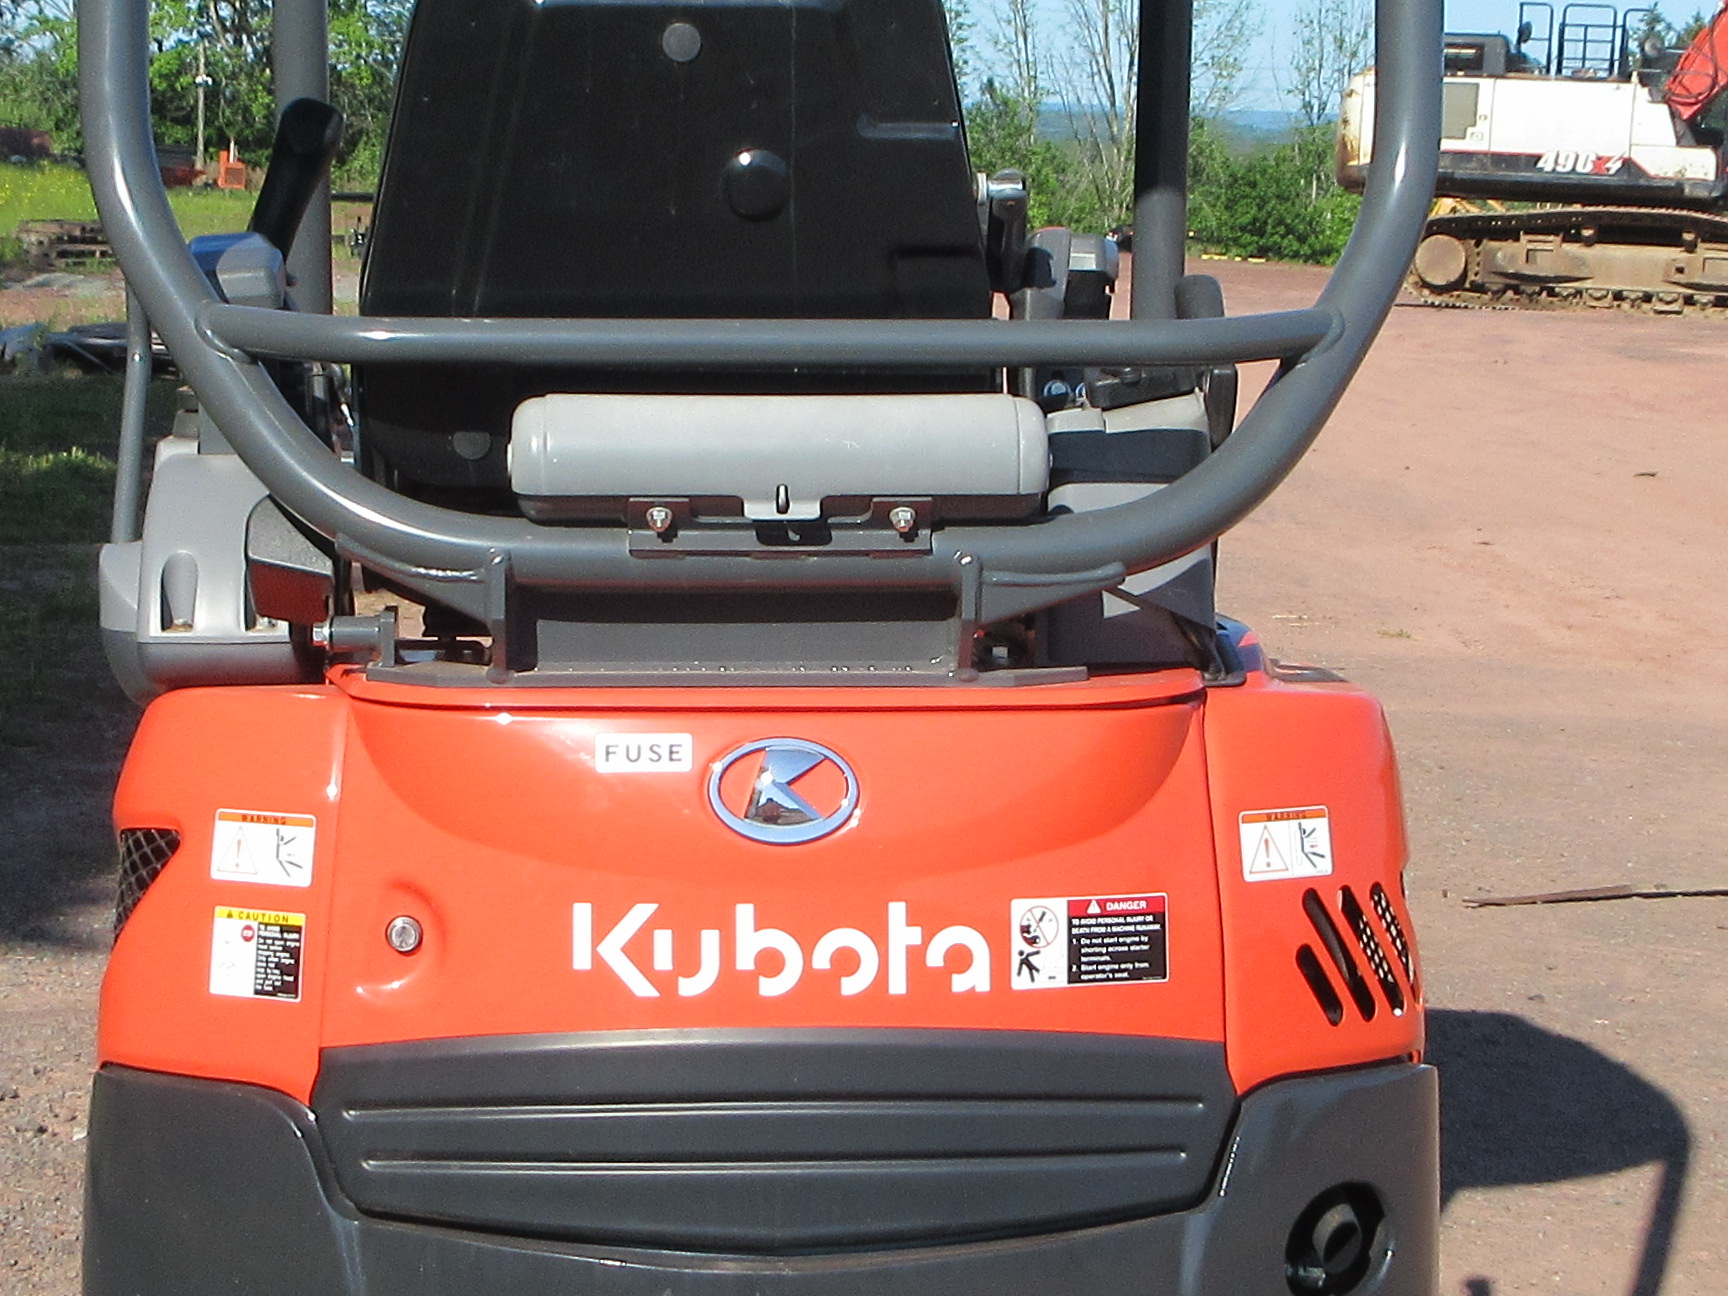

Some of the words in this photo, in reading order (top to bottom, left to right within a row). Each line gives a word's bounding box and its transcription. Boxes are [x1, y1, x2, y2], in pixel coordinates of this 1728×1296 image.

[604, 744, 683, 763] FUSE
[1106, 900, 1147, 911] DANGER
[237, 911, 289, 923] CAUTION
[573, 901, 992, 997] Kubota
